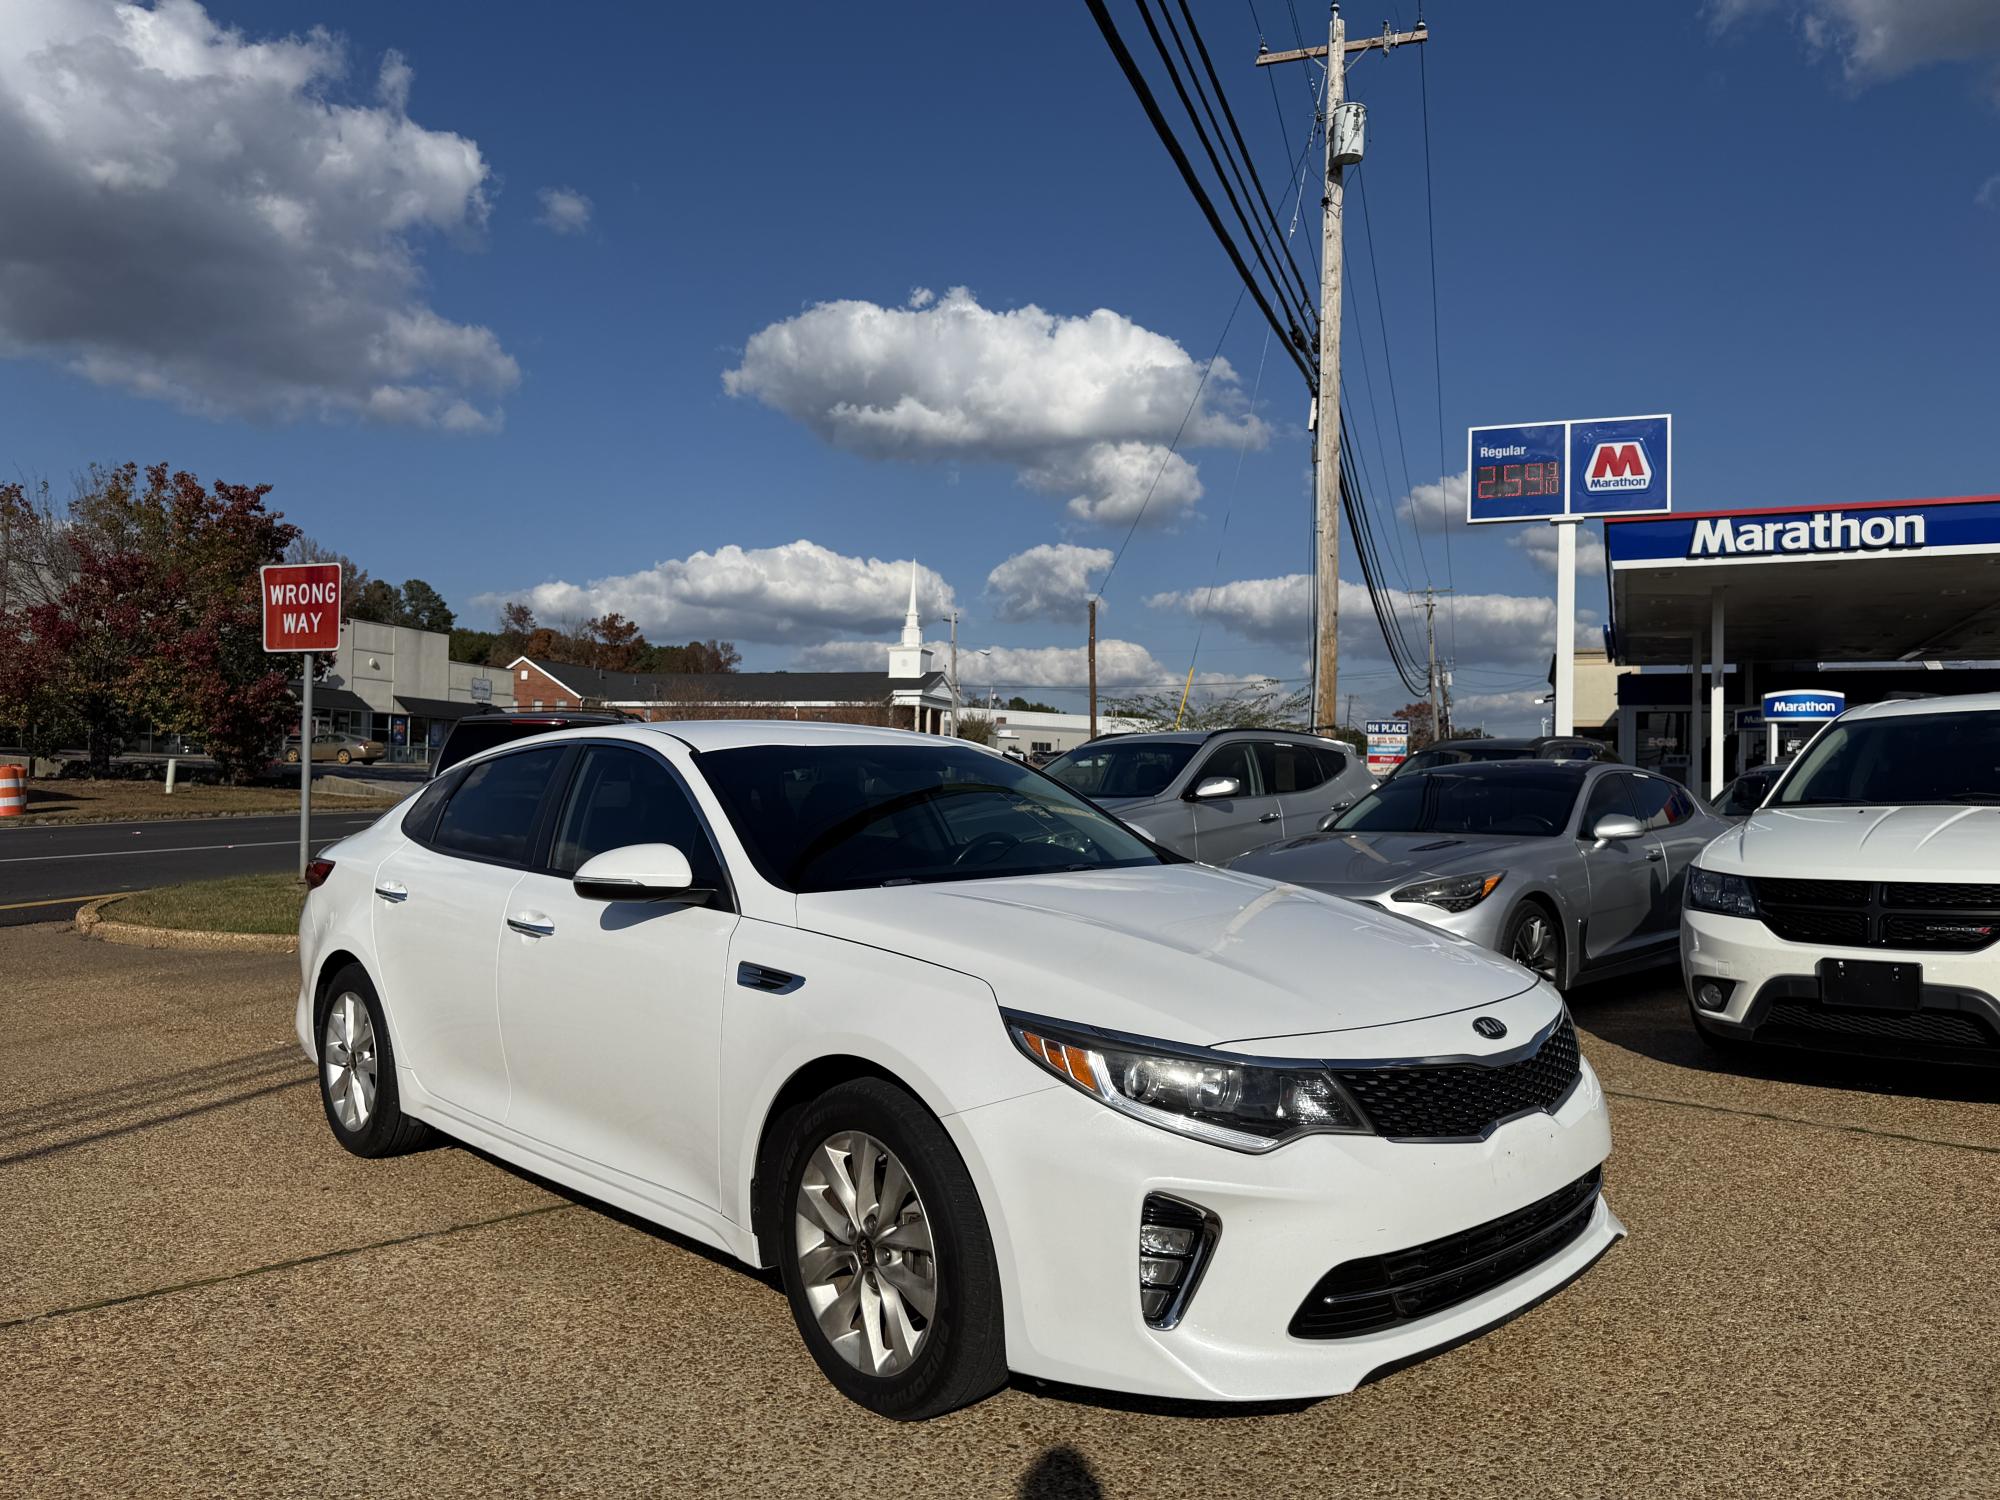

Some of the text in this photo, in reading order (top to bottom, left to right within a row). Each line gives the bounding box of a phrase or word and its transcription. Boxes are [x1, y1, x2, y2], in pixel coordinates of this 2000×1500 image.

[1480, 445, 1527, 459] Regular
[1590, 477, 1647, 489] Marathon
[1691, 512, 1925, 554] Marathon
[270, 582, 336, 606] WRONG
[283, 612, 323, 634] WAY
[1773, 701, 1836, 713] Marathon
[1367, 724, 1407, 733] 914 PLACE
[1476, 1019, 1506, 1035] KIA
